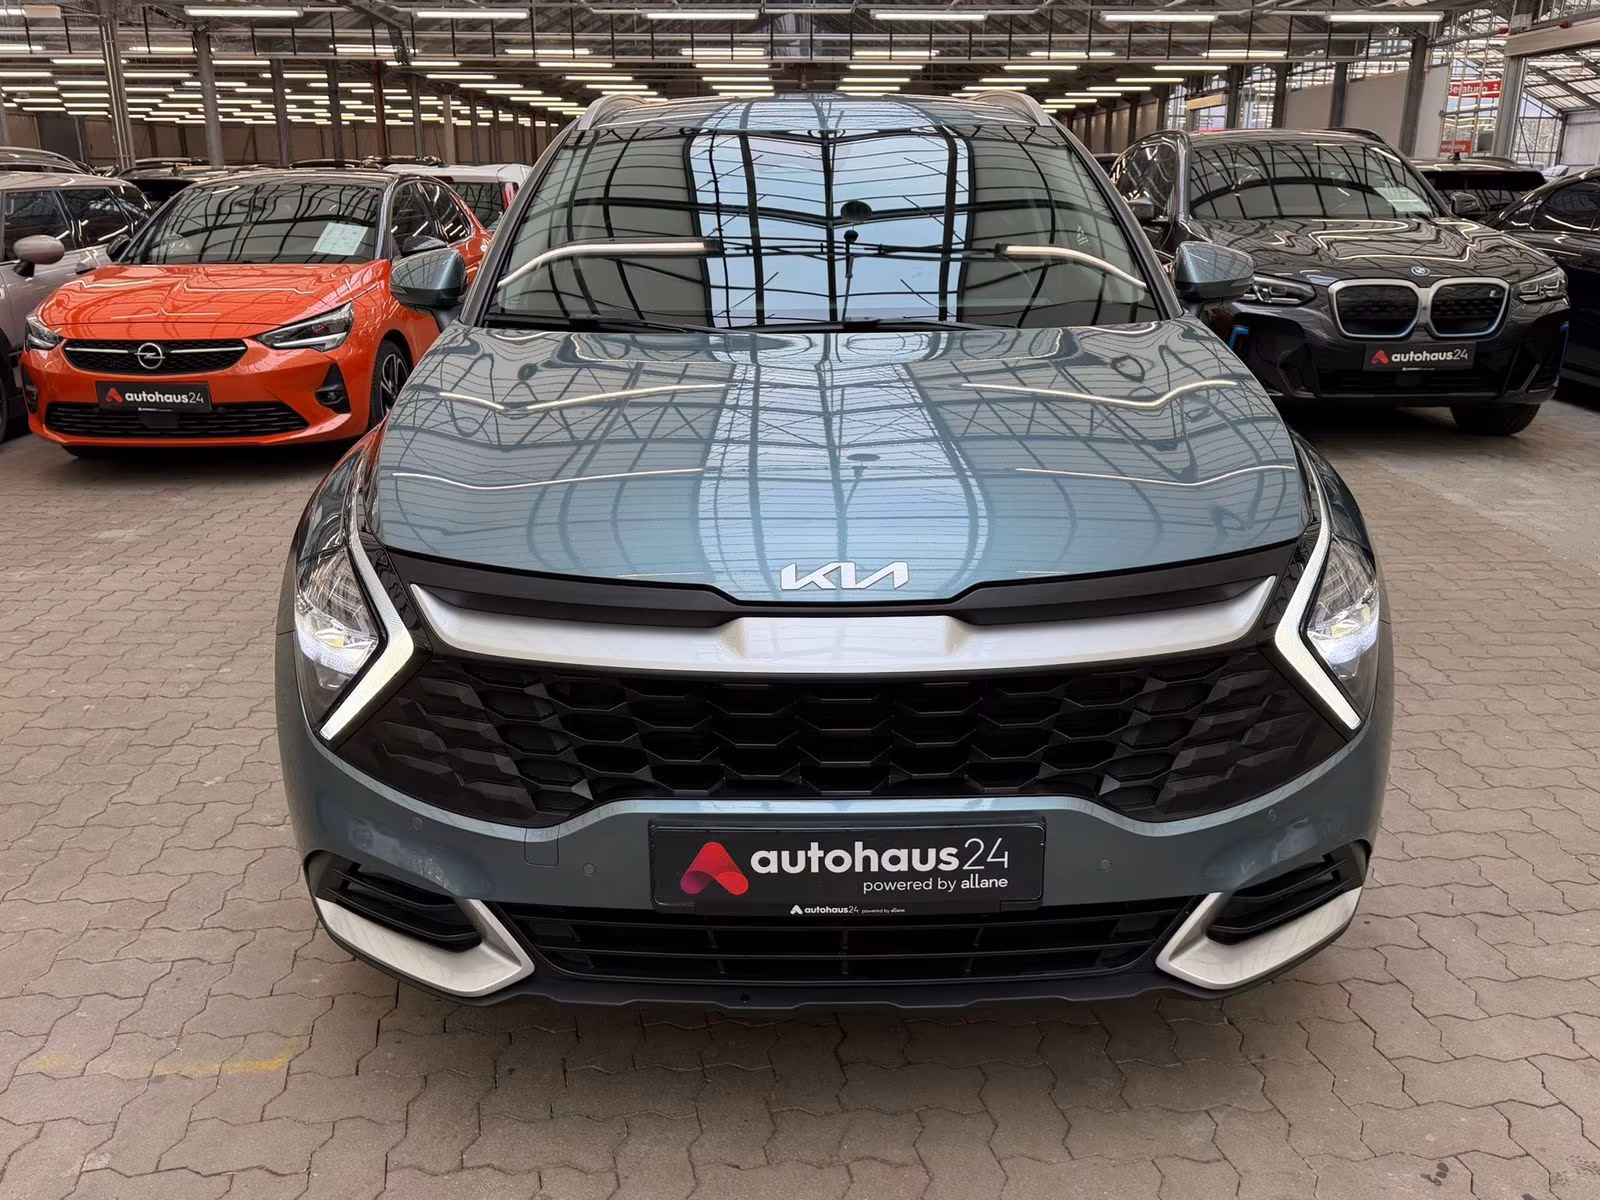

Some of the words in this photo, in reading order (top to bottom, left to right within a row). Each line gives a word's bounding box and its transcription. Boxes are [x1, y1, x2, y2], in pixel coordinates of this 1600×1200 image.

[1449, 84, 1488, 94] Beatung
[1391, 349, 1468, 362] autohaus24
[125, 391, 204, 404] autohaus24
[781, 561, 909, 590] KIA
[750, 837, 1009, 874] autohaus24
[863, 878, 933, 895] powered
[938, 877, 957, 893] by
[960, 873, 1008, 890] allane
[804, 905, 859, 914] autohaus24
